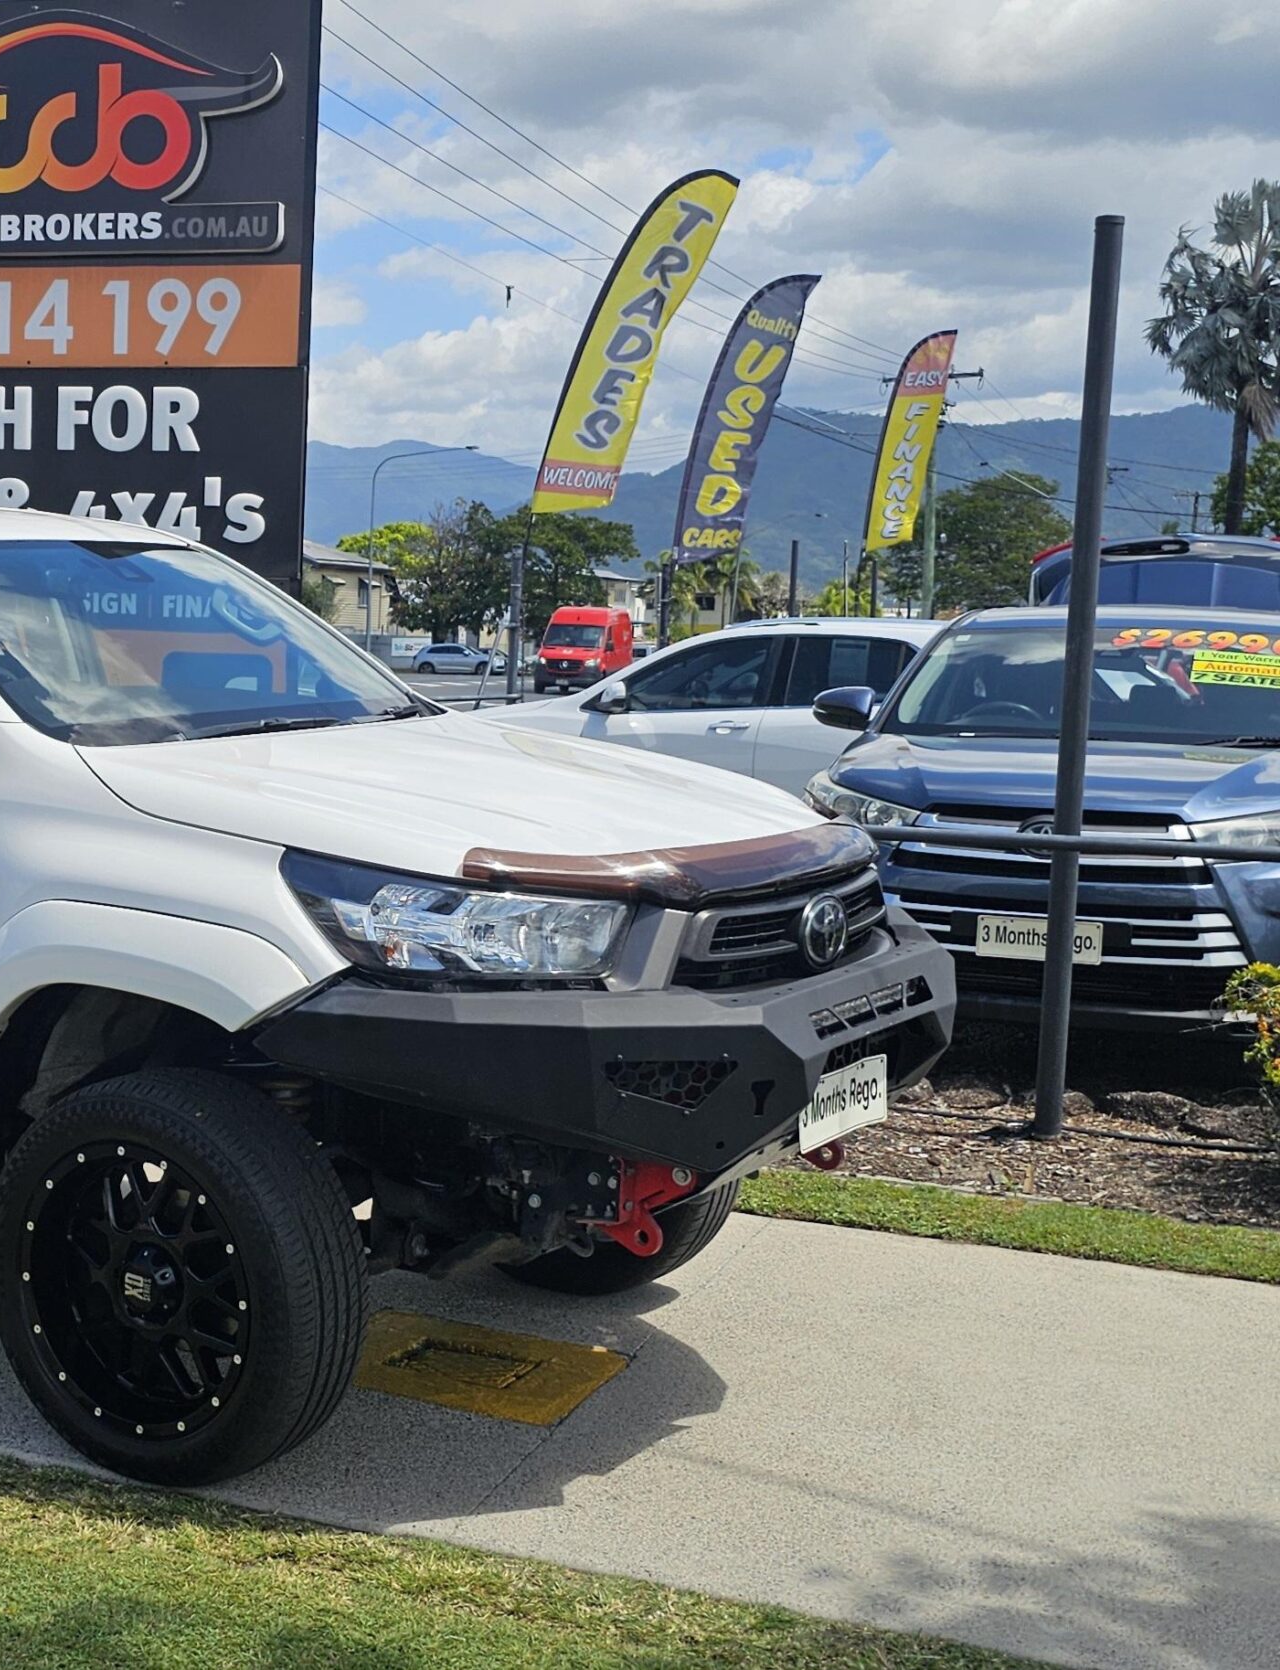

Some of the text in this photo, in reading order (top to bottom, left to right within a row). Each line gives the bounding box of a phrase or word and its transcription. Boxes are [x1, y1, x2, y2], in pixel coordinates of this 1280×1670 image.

[102, 277, 242, 356] 199
[575, 200, 714, 450] TRADES
[904, 371, 945, 387] EASY
[56, 386, 200, 452] FOR
[695, 339, 786, 516] USED
[880, 402, 930, 538] FINANCE
[682, 527, 742, 549] CARS
[1111, 628, 1280, 656] $2699
[1211, 652, 1239, 660] Year
[1193, 672, 1208, 680] 7
[981, 924, 1097, 954] 3 Months go.
[811, 1084, 847, 1124] Months
[849, 1077, 882, 1111] Rego.
